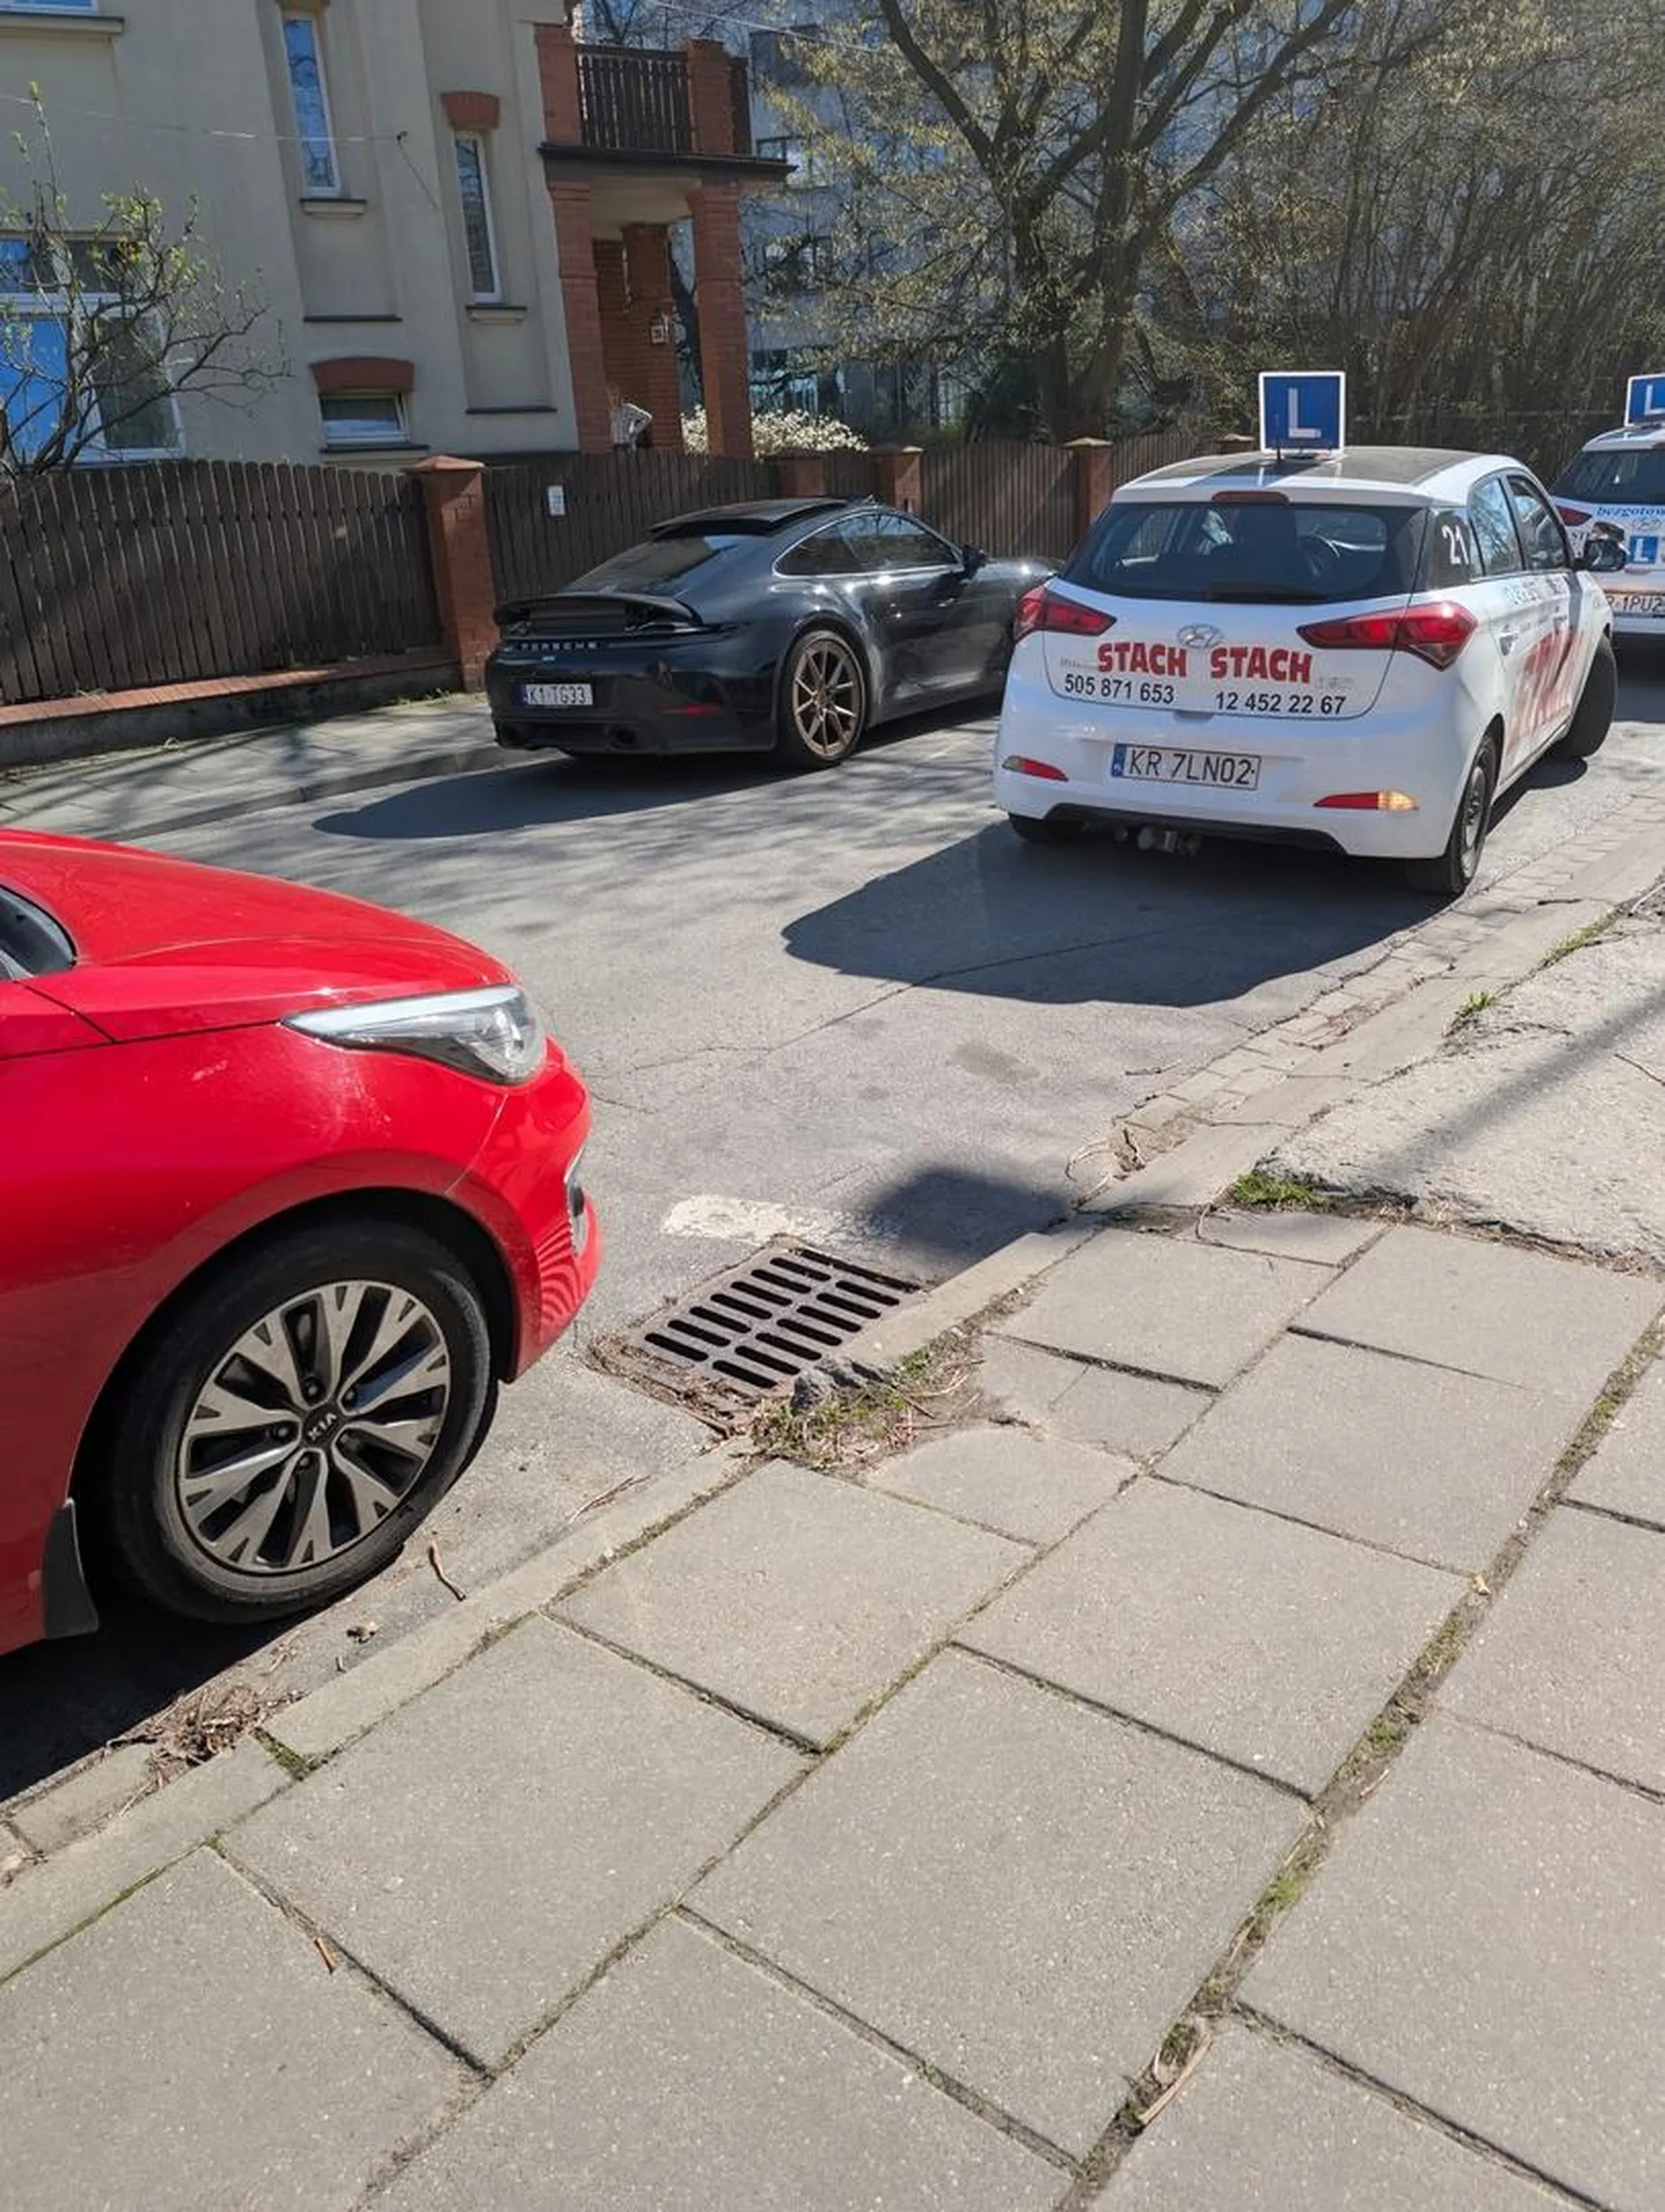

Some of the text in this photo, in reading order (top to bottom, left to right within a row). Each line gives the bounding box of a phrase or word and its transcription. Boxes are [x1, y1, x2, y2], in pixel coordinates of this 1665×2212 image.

[1288, 388, 1322, 439] L
[1645, 385, 1665, 415] L
[1441, 525, 1469, 565] 21
[1633, 538, 1649, 562] L
[1097, 641, 1313, 684] STACH STACH
[1064, 673, 1175, 704] 505 871 653
[1216, 691, 1347, 715] 12 452 22 67
[1129, 749, 1252, 786] KR 7LN02
[308, 1413, 336, 1441] KIA
